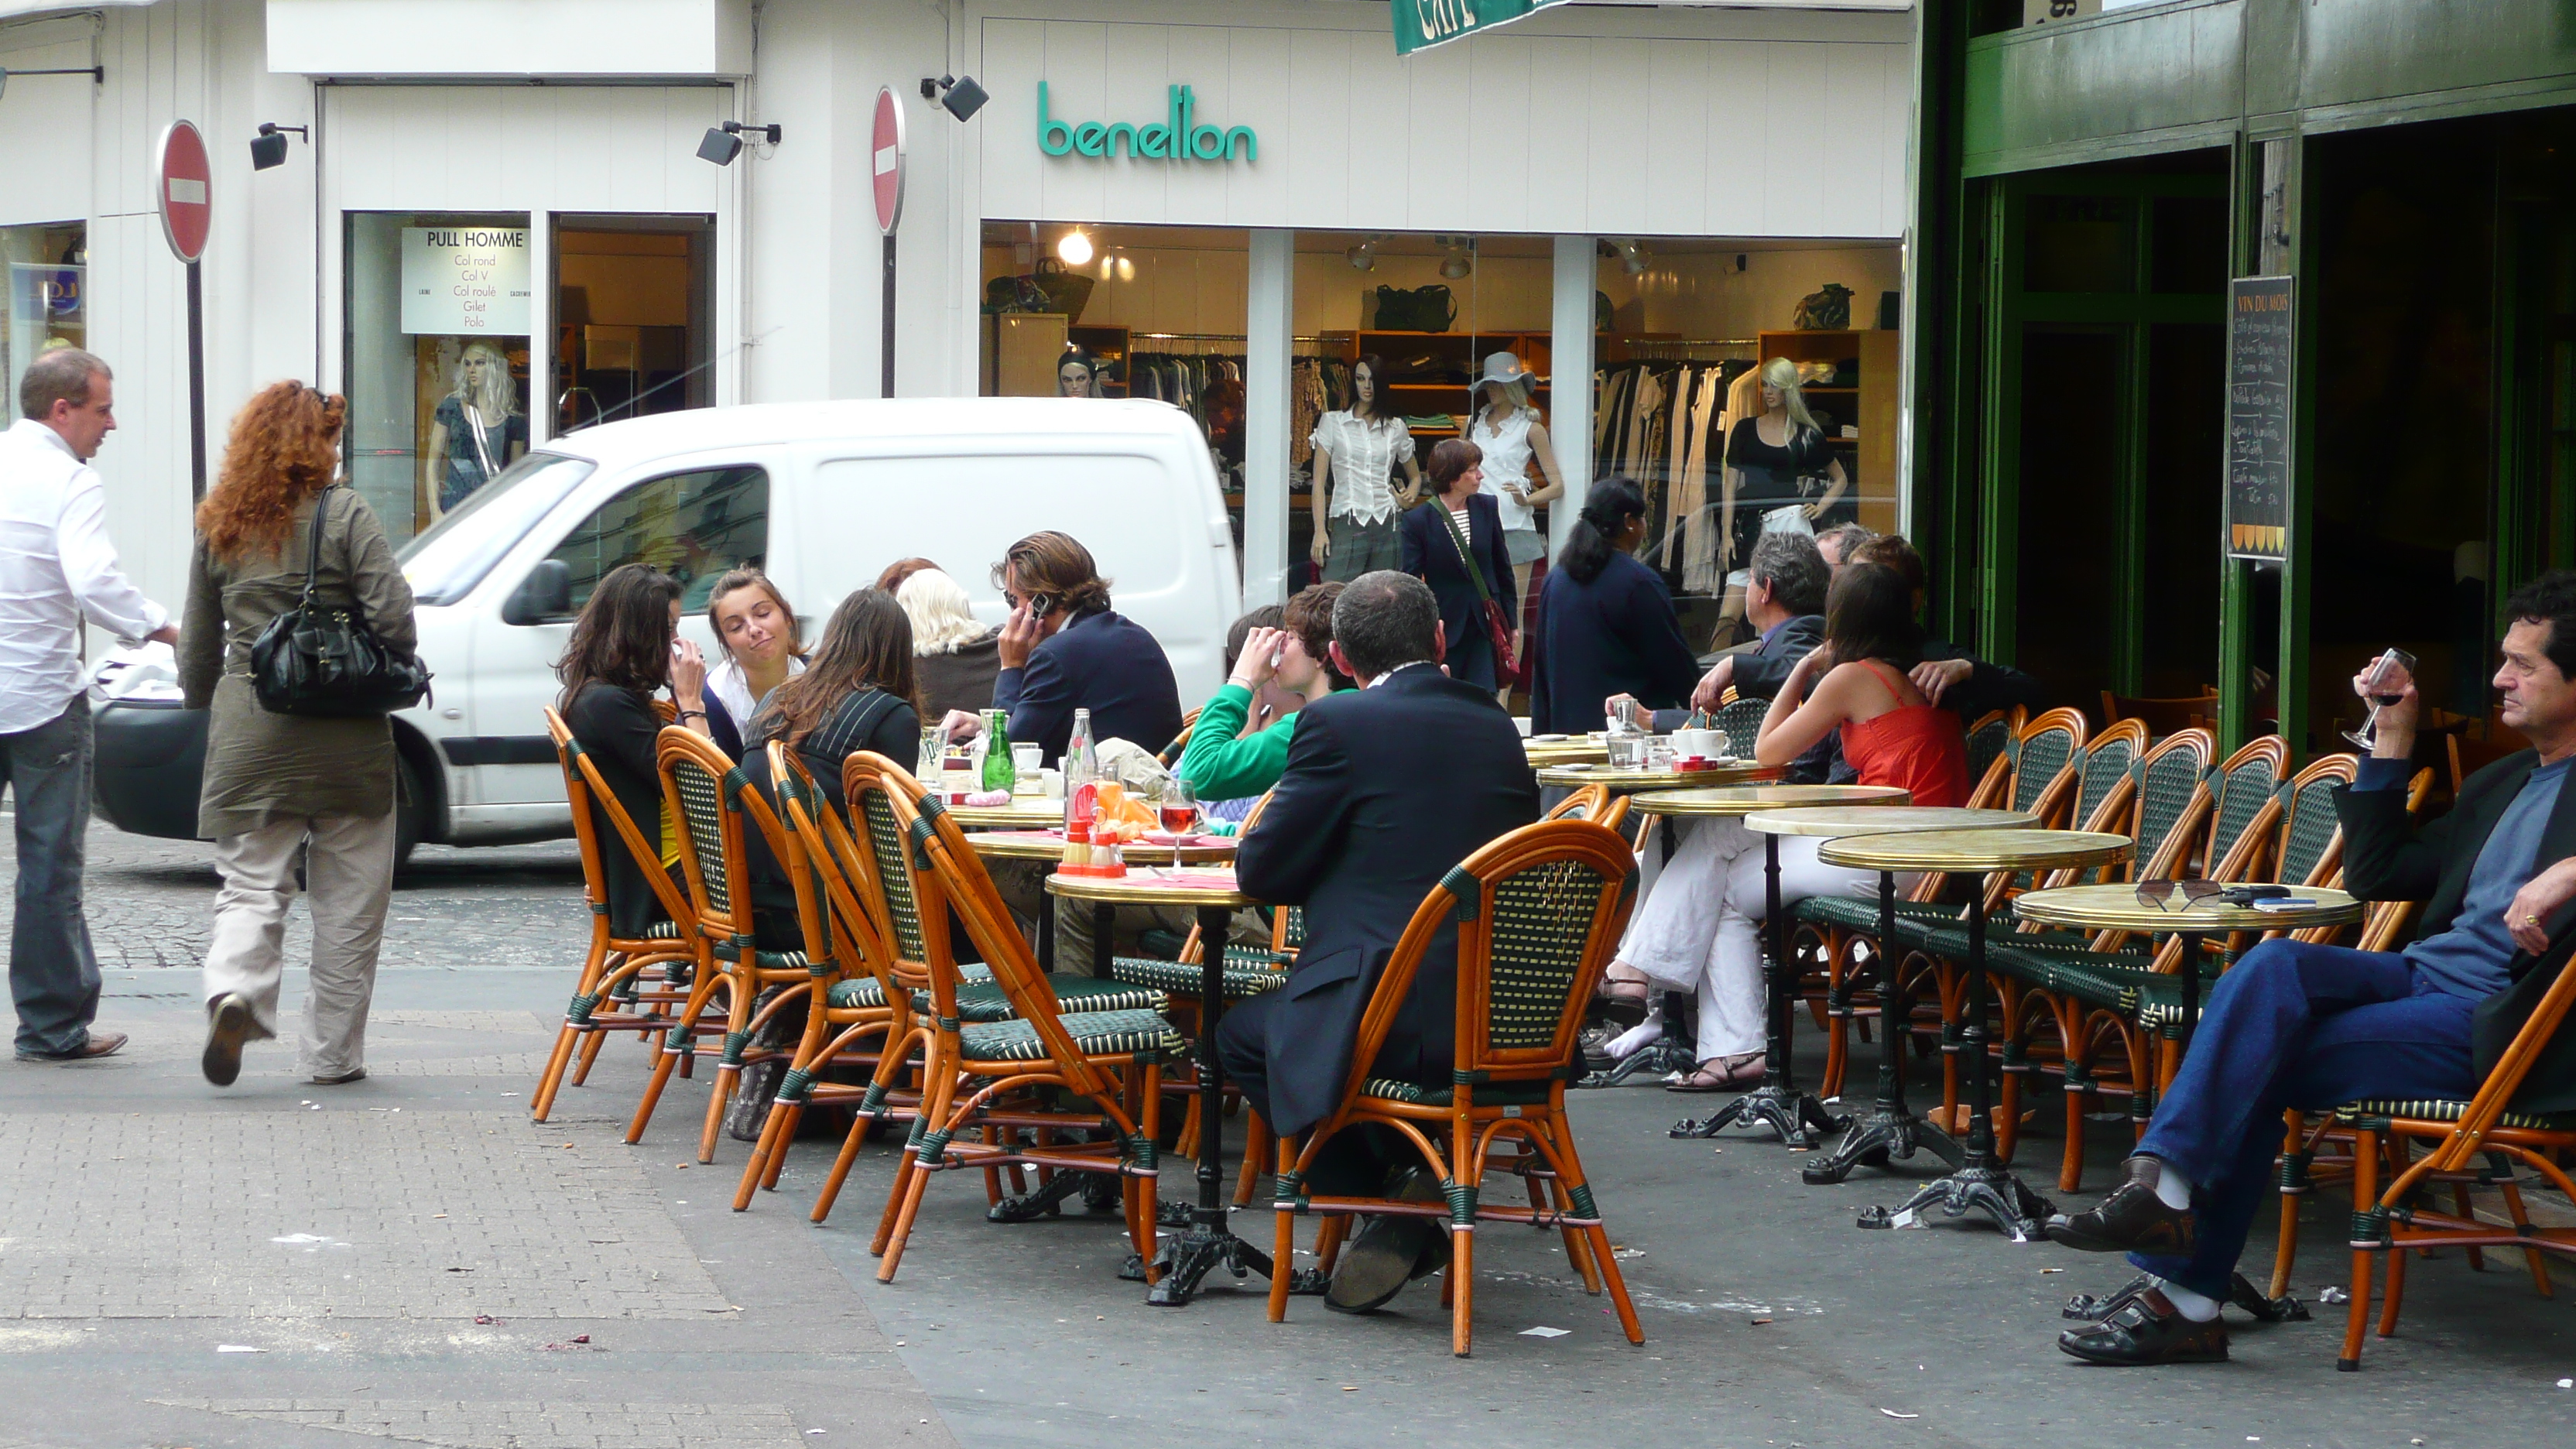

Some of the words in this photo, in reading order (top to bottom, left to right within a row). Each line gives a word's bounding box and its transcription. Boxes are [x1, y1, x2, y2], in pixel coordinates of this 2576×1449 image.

[1038, 80, 1257, 160] benetton
[427, 232, 460, 246] PULL
[465, 232, 522, 247] HOMME
[454, 255, 471, 265] Col
[474, 255, 496, 265] rond
[462, 270, 478, 281] Col
[481, 271, 488, 281] V
[454, 286, 469, 296] Col
[473, 286, 496, 296] roulé
[463, 301, 486, 312] Gilet
[2238, 296, 2253, 312] VIN
[2256, 295, 2267, 312] DU
[2269, 294, 2288, 311] MOIS
[464, 315, 485, 327] Polo
